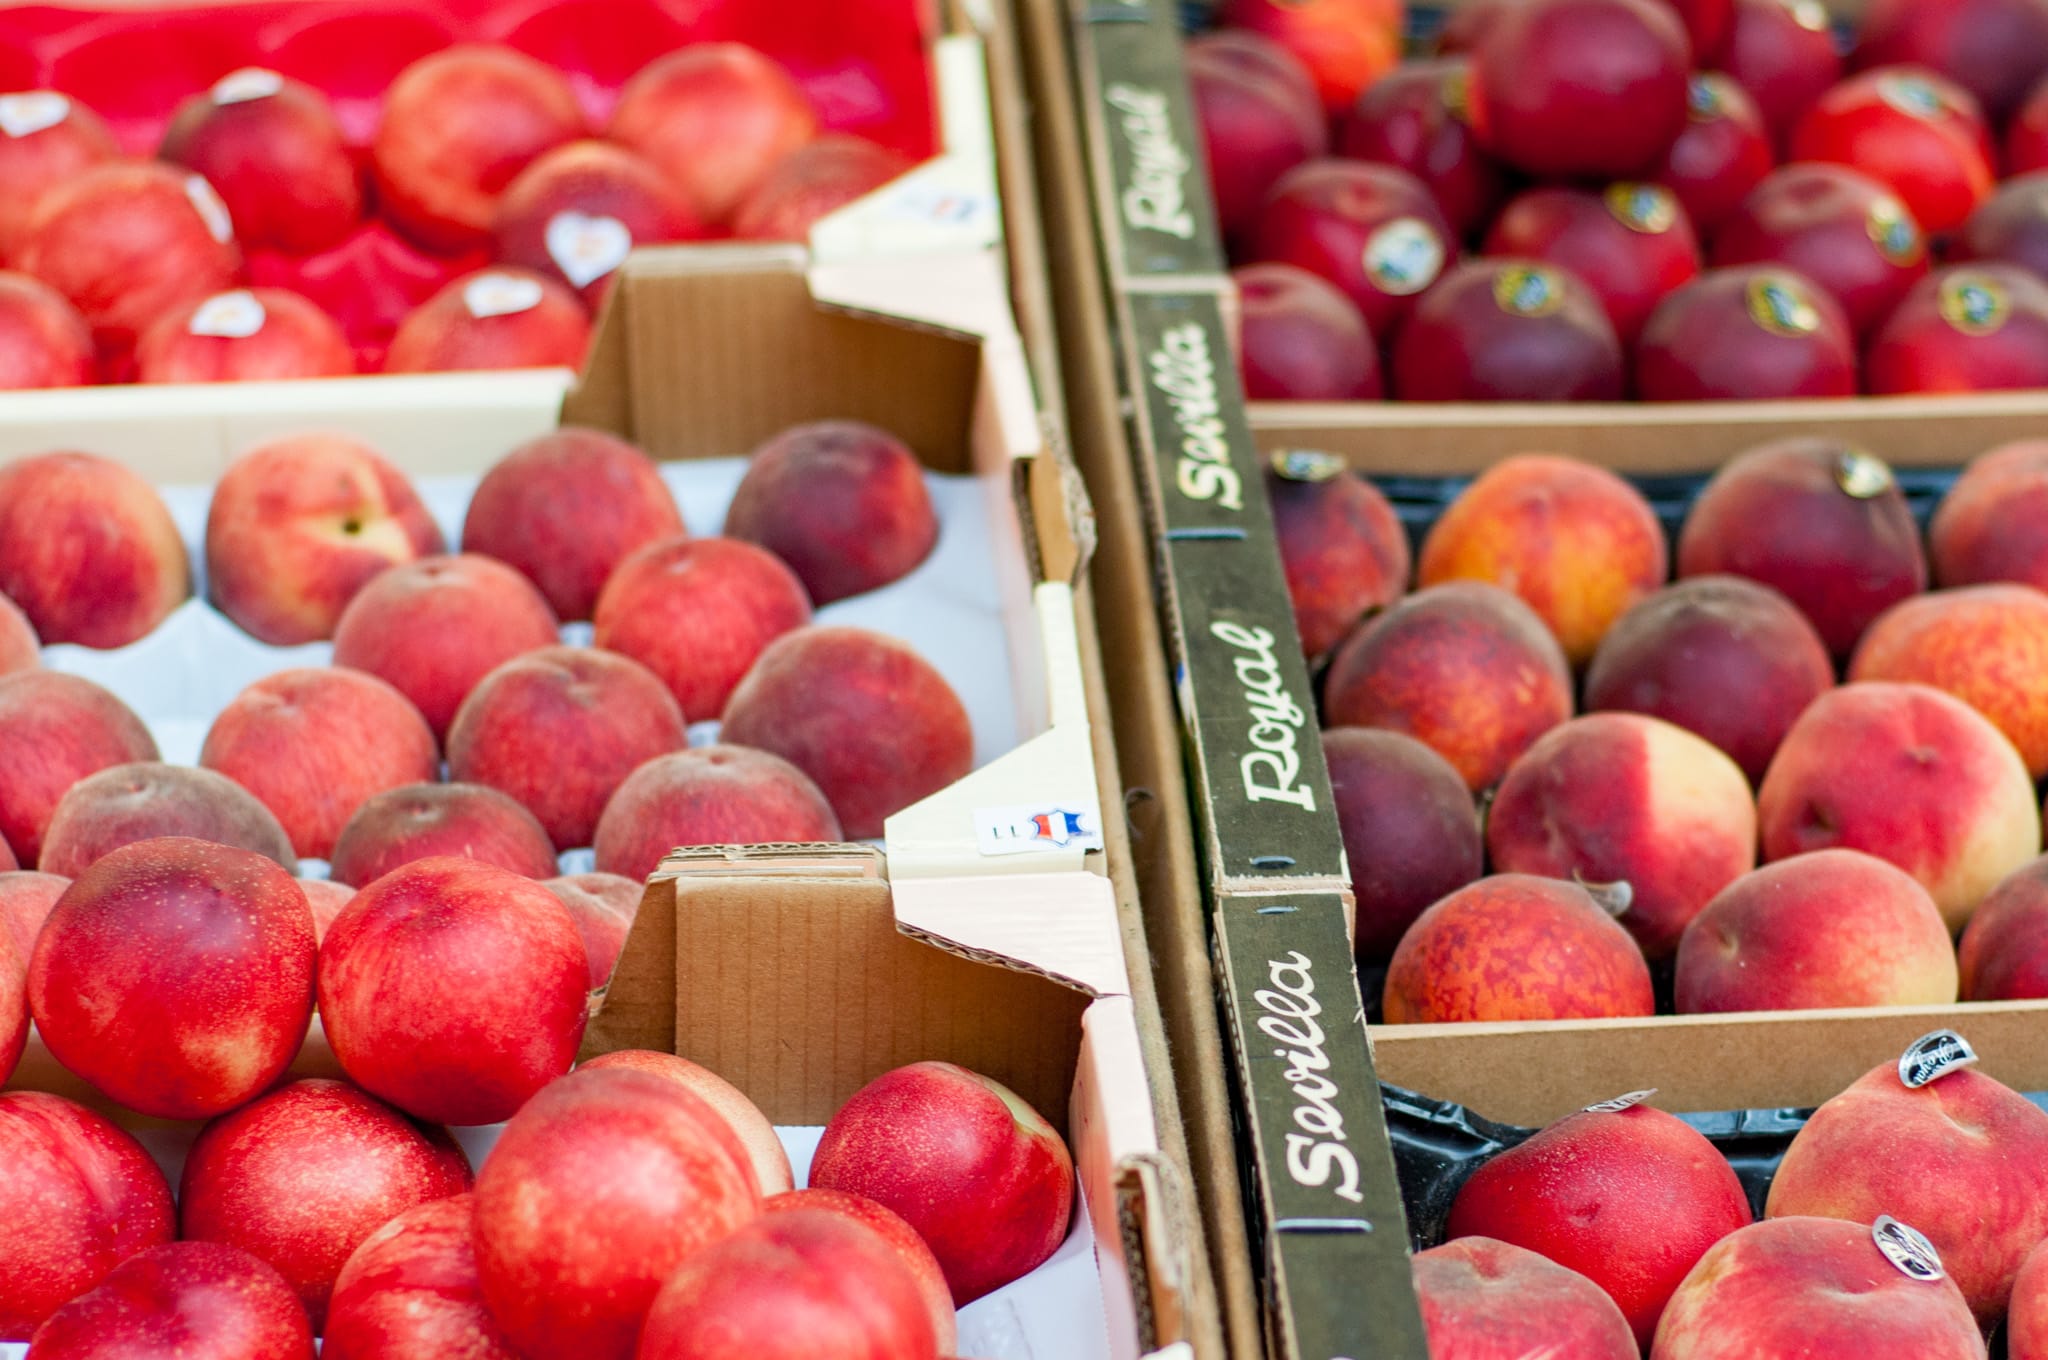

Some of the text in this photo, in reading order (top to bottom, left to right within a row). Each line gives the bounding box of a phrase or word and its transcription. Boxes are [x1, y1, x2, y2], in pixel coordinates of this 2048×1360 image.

[1106, 83, 1195, 240] Royal
[1149, 322, 1316, 812] Royal Sevilla
[1252, 950, 1364, 1203] Sevilla
